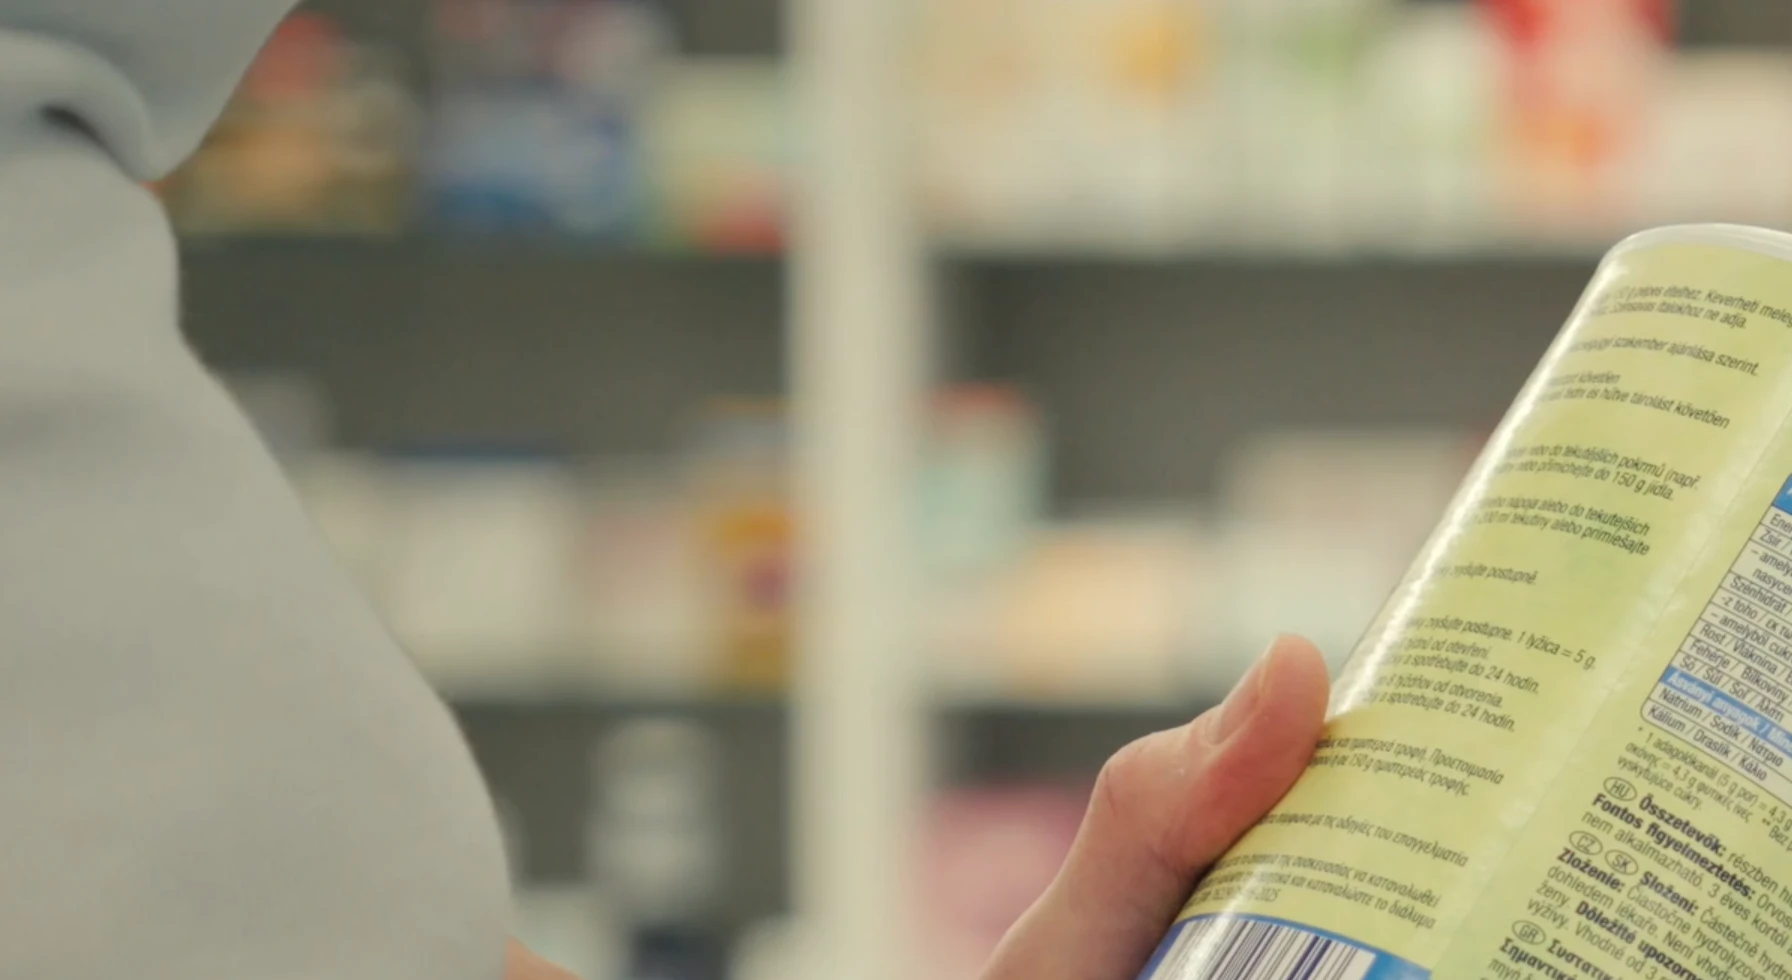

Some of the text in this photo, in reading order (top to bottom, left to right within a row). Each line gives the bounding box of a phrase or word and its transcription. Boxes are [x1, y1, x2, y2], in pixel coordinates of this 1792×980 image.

[1718, 312, 1747, 329] adja.
[1714, 353, 1759, 376] szerint.
[1615, 455, 1666, 478] pokrmů
[1592, 466, 1611, 481] do
[1611, 470, 1638, 488] 150
[1642, 481, 1674, 500] jídla.
[1567, 502, 1585, 522] do
[1549, 518, 1583, 535] alebo
[1756, 527, 1782, 552] Zsír
[1732, 598, 1758, 620] toho
[1525, 633, 1561, 655] lyžica
[1698, 622, 1727, 645] Rost
[1467, 662, 1485, 677] do
[1483, 664, 1505, 681] 24
[1443, 699, 1480, 718] do 24
[1658, 687, 1703, 718] Nátrium
[1647, 704, 1686, 732] Kálium
[1591, 792, 1643, 829] Fontos
[1580, 810, 1614, 834] nem
[1718, 891, 1751, 921] éves
[1726, 852, 1779, 893] részben
[1546, 865, 1614, 909] dohledem
[1574, 920, 1625, 960] Vhodné
[1624, 954, 1647, 974] od
